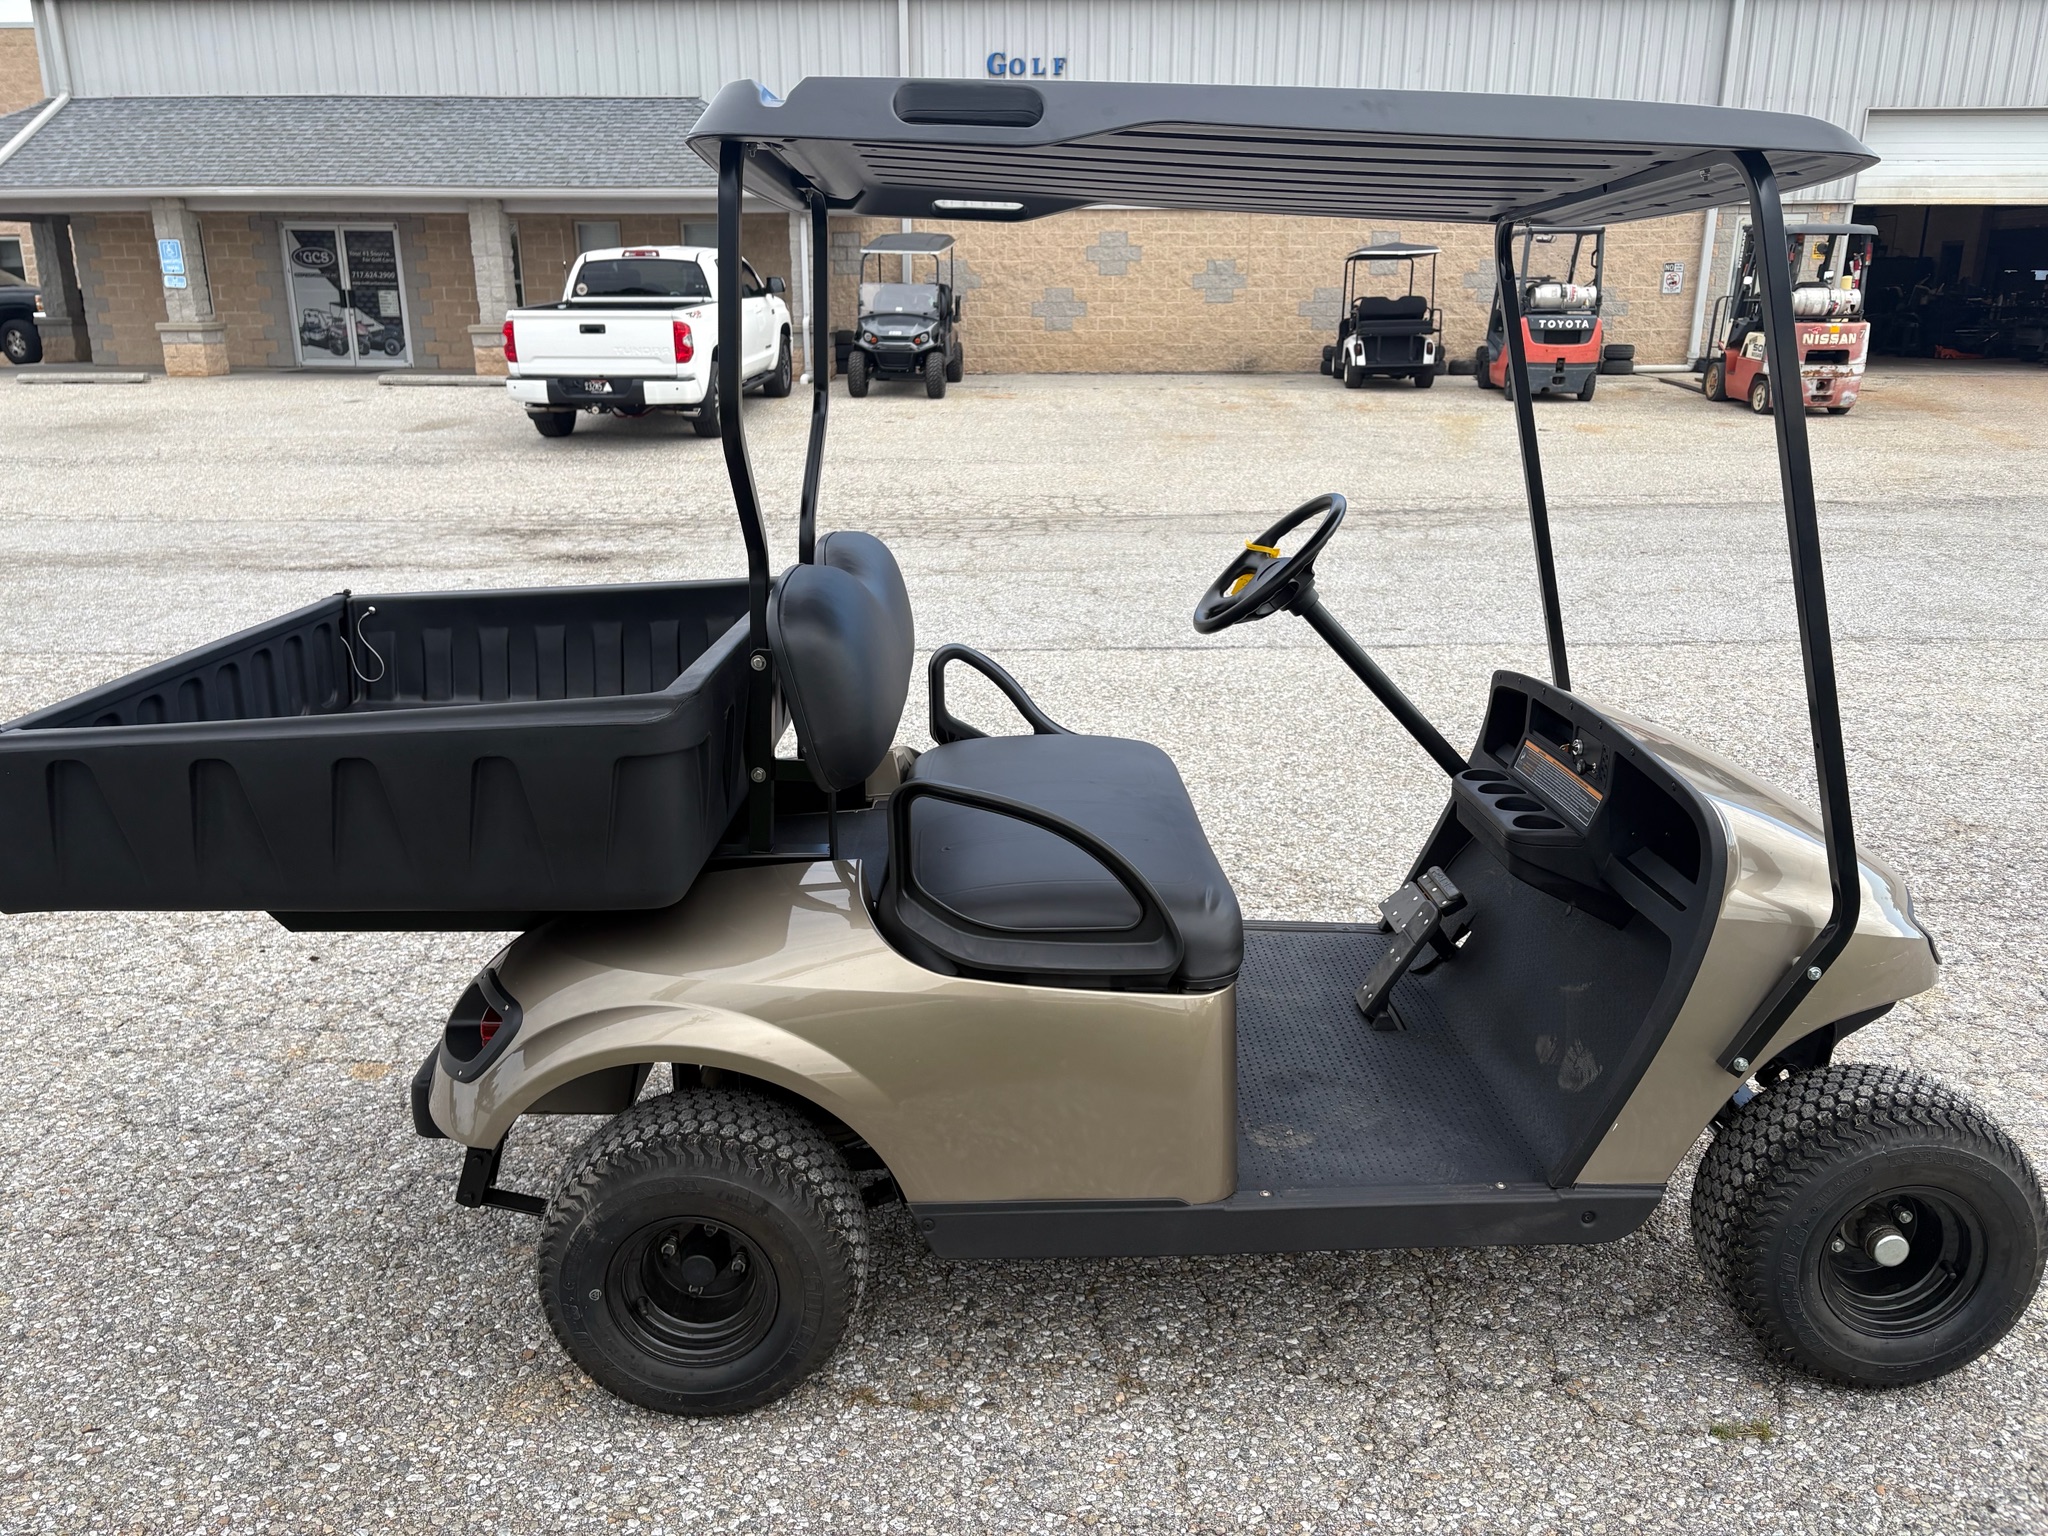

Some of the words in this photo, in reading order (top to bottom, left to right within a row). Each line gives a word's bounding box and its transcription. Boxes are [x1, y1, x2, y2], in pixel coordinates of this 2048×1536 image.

[302, 252, 330, 264] GCS
[1538, 319, 1590, 329] TOYOTA
[1802, 333, 1857, 345] NISSAN
[1859, 329, 1866, 337] 7
[613, 346, 671, 356] TUNDRA
[1887, 1149, 1992, 1183] KENDA
